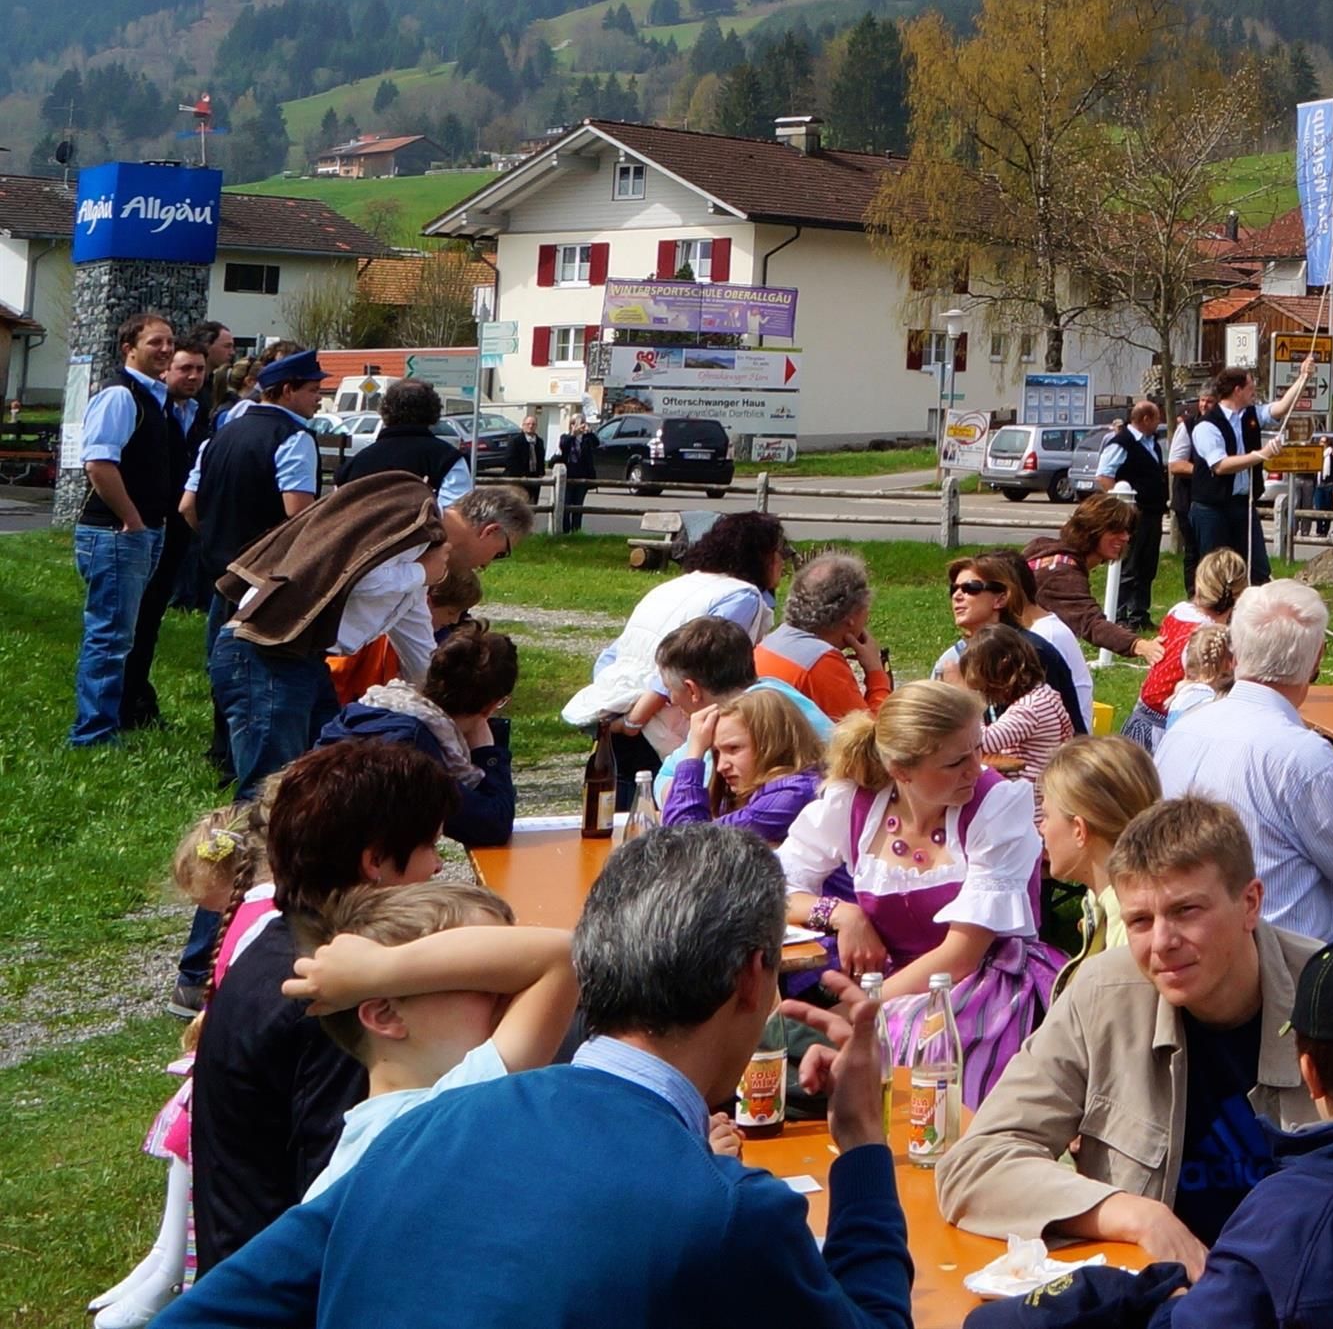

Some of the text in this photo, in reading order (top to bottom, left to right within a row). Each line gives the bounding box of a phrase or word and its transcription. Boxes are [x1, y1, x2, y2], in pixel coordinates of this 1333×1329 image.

[77, 193, 114, 235] Allgäu
[120, 196, 213, 233] Allgäu
[611, 284, 723, 298] WINTERSPORTSCHULE
[724, 289, 792, 304] OBERALLGÄU
[1236, 335, 1248, 348] 30
[662, 396, 766, 409] Ofterschwanger Haus
[750, 1070, 778, 1080] COLA
